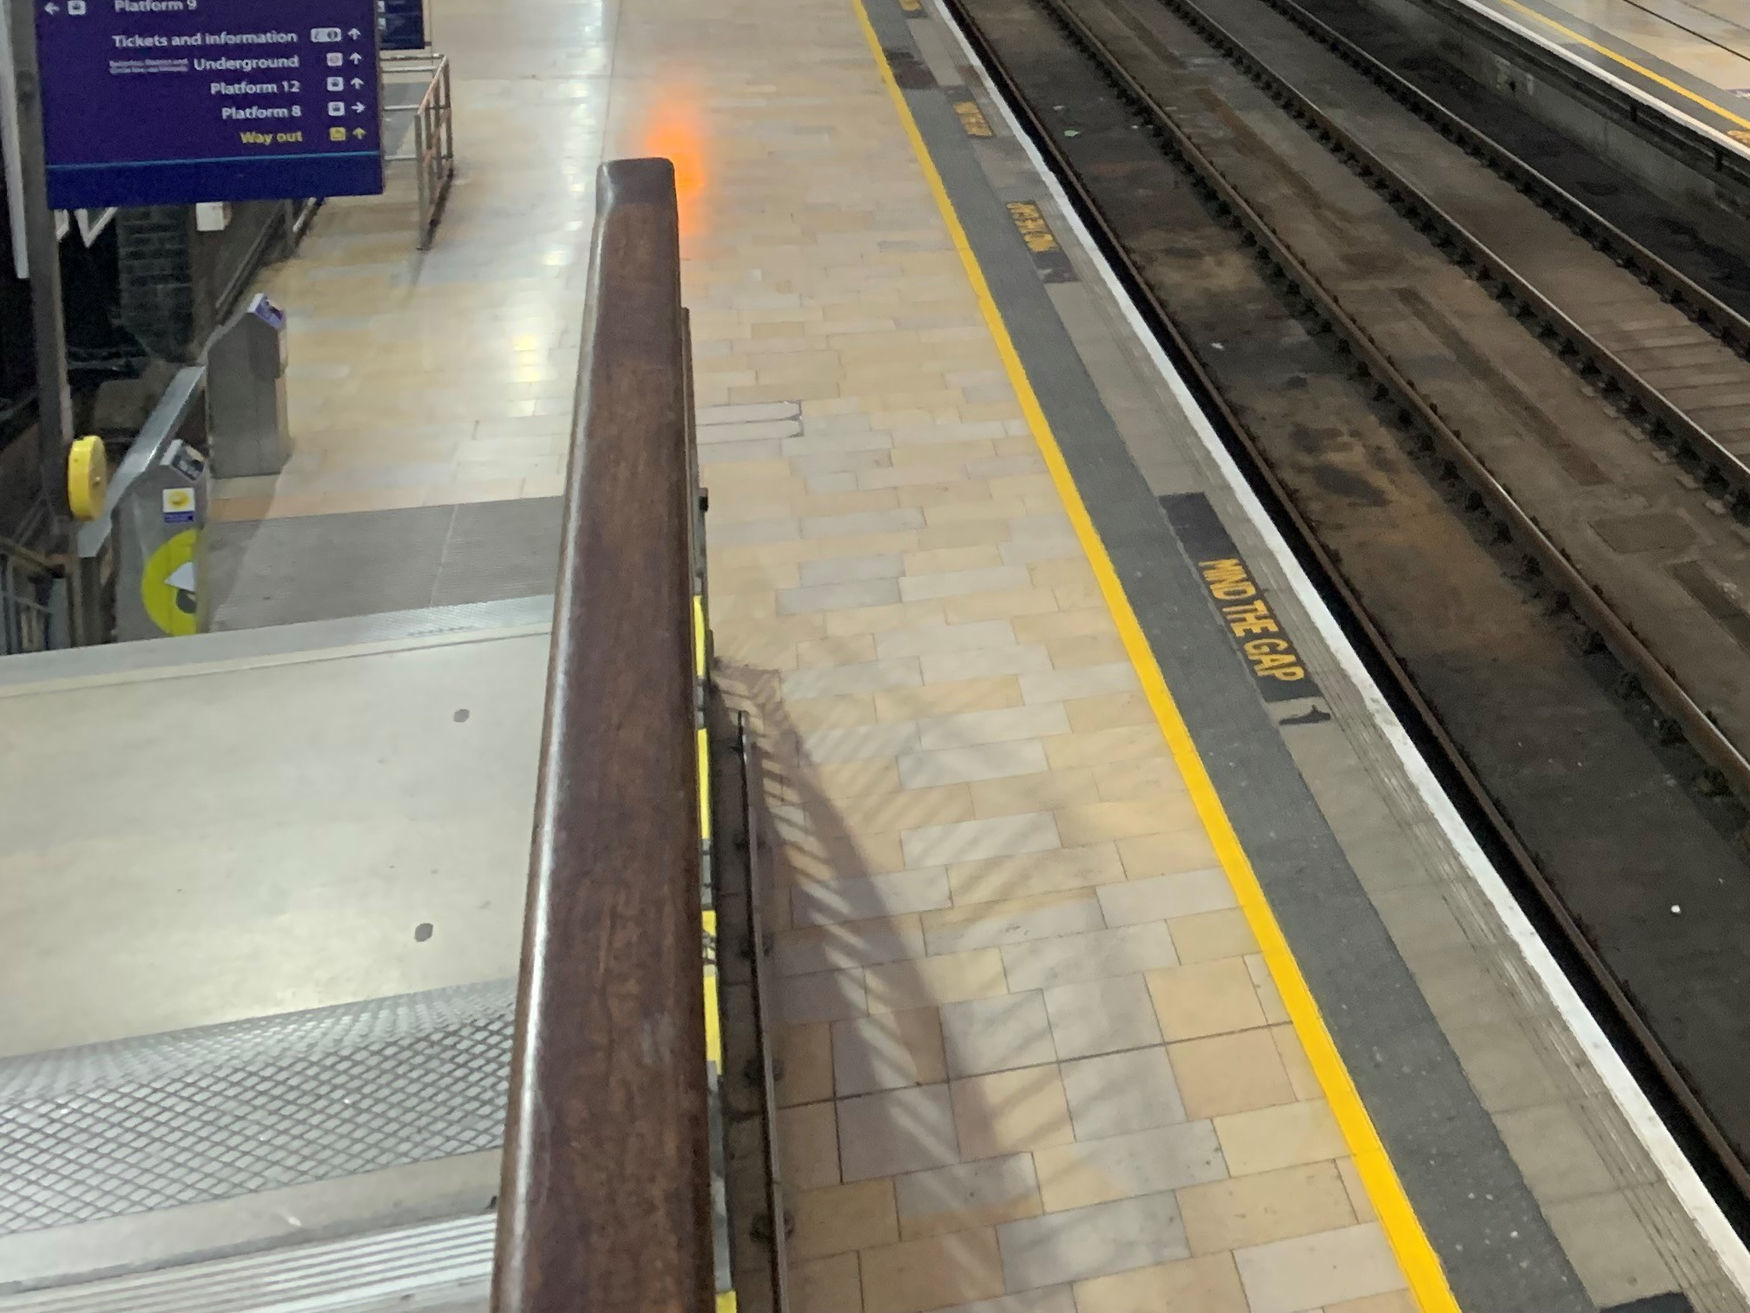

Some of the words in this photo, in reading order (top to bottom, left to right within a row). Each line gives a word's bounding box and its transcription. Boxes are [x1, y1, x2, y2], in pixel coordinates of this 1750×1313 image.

[112, 34, 168, 48] Tickets
[171, 33, 201, 46] and
[205, 30, 298, 45] information
[193, 55, 299, 72] Underground
[210, 81, 278, 95] Platform
[282, 80, 301, 92] 12
[221, 105, 288, 119] Platform
[291, 105, 302, 117] 8
[240, 131, 273, 146] Way
[276, 131, 302, 143] out
[1198, 558, 1257, 600] MIND
[1222, 599, 1279, 638] THE
[1243, 638, 1305, 681] GAP
